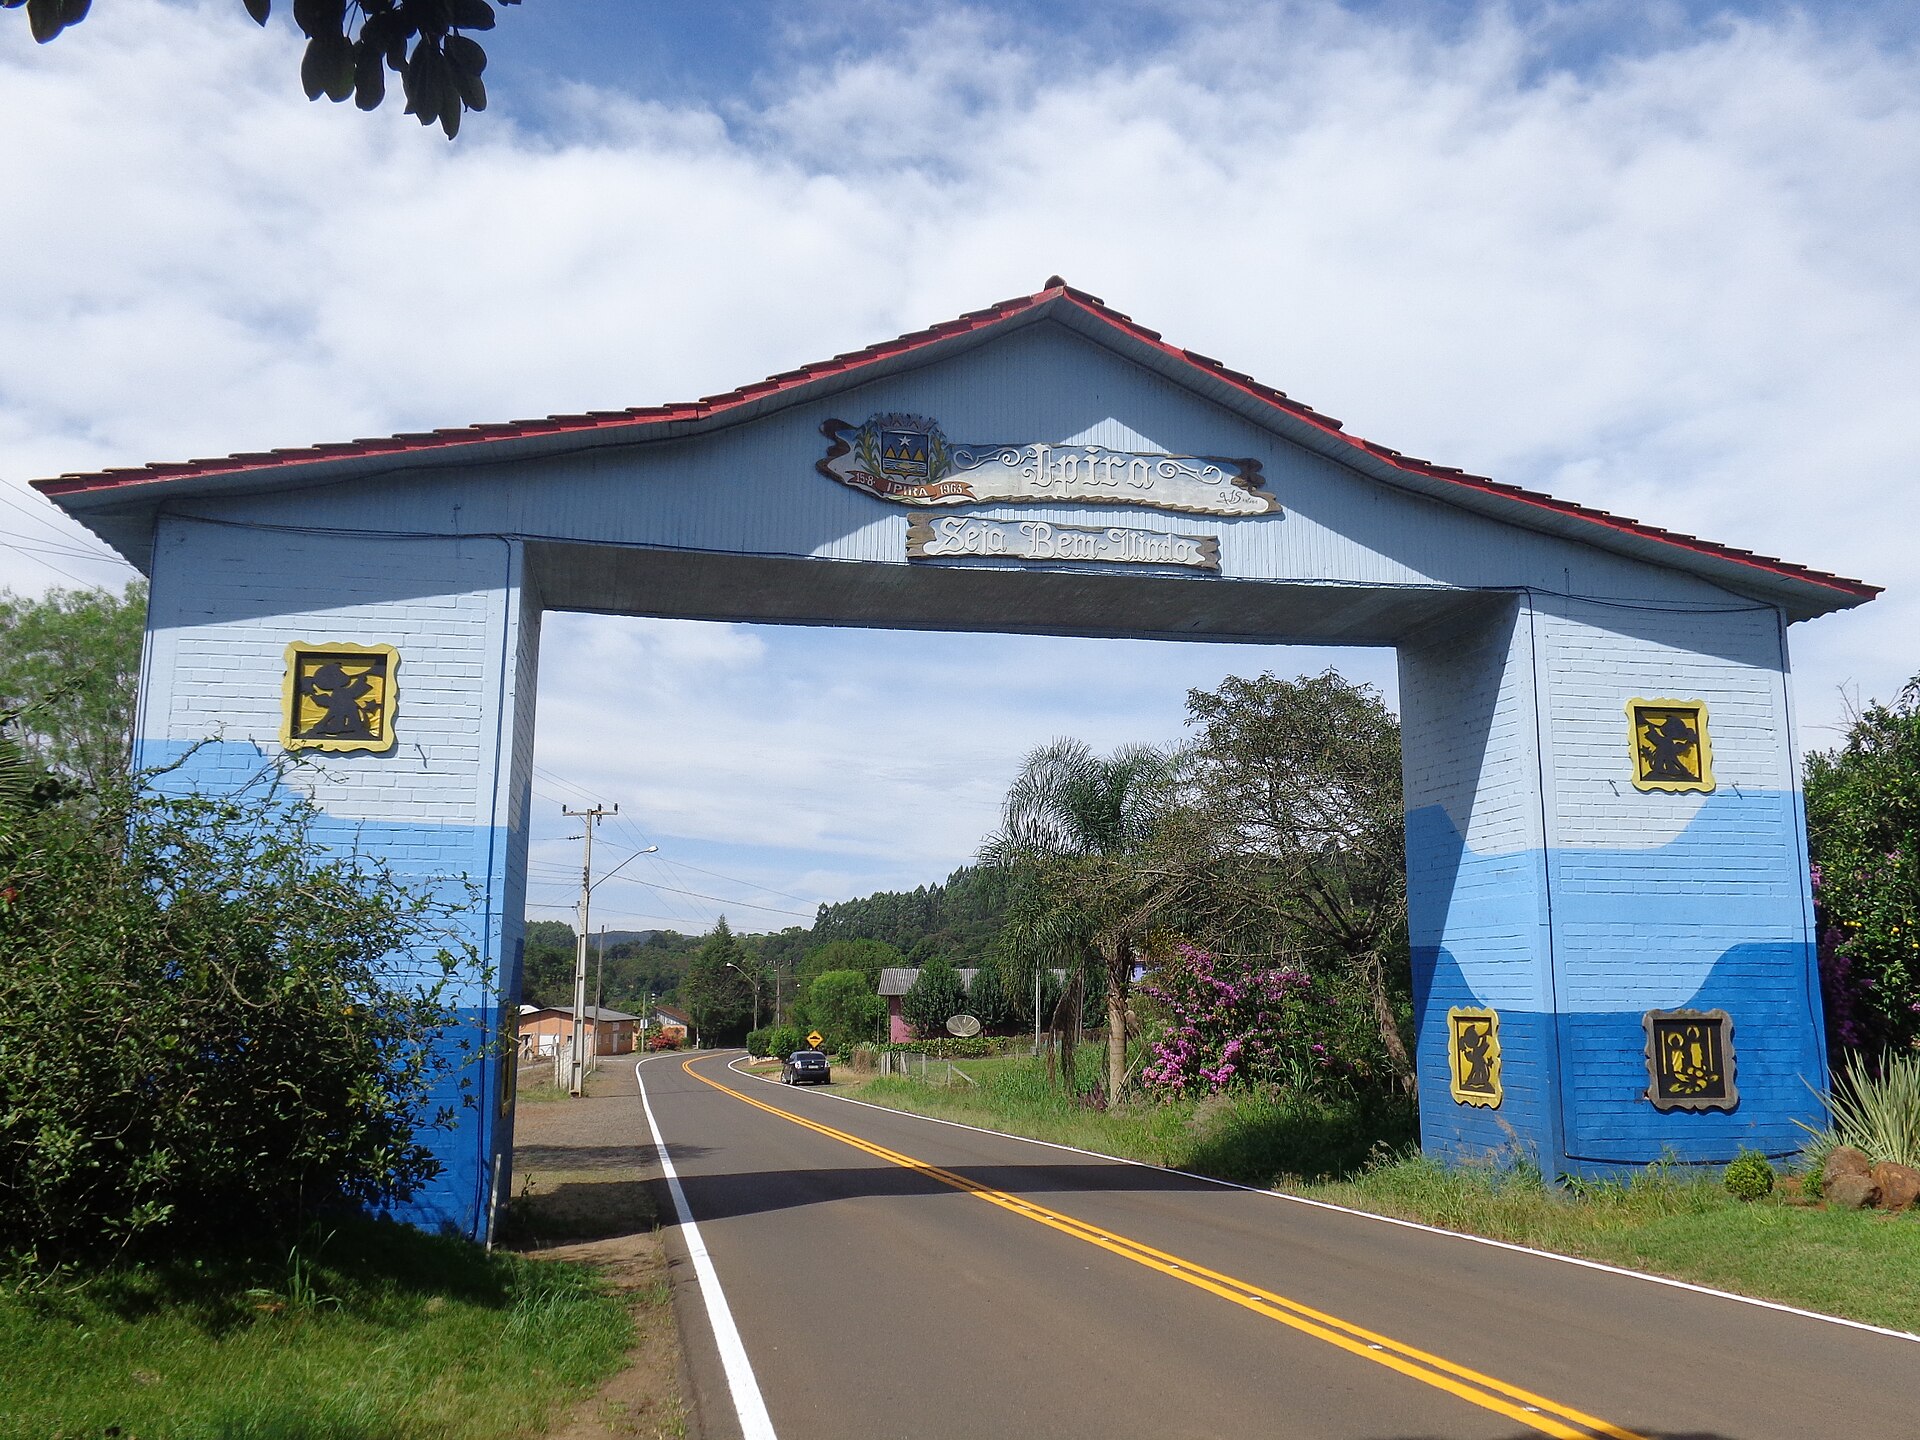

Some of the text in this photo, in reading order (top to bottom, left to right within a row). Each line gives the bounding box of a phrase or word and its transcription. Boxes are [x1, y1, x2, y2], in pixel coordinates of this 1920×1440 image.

[1022, 443, 1154, 495] Ipira
[886, 482, 928, 496] IPIRA
[940, 483, 963, 494] 1963
[936, 516, 1007, 555] Seja
